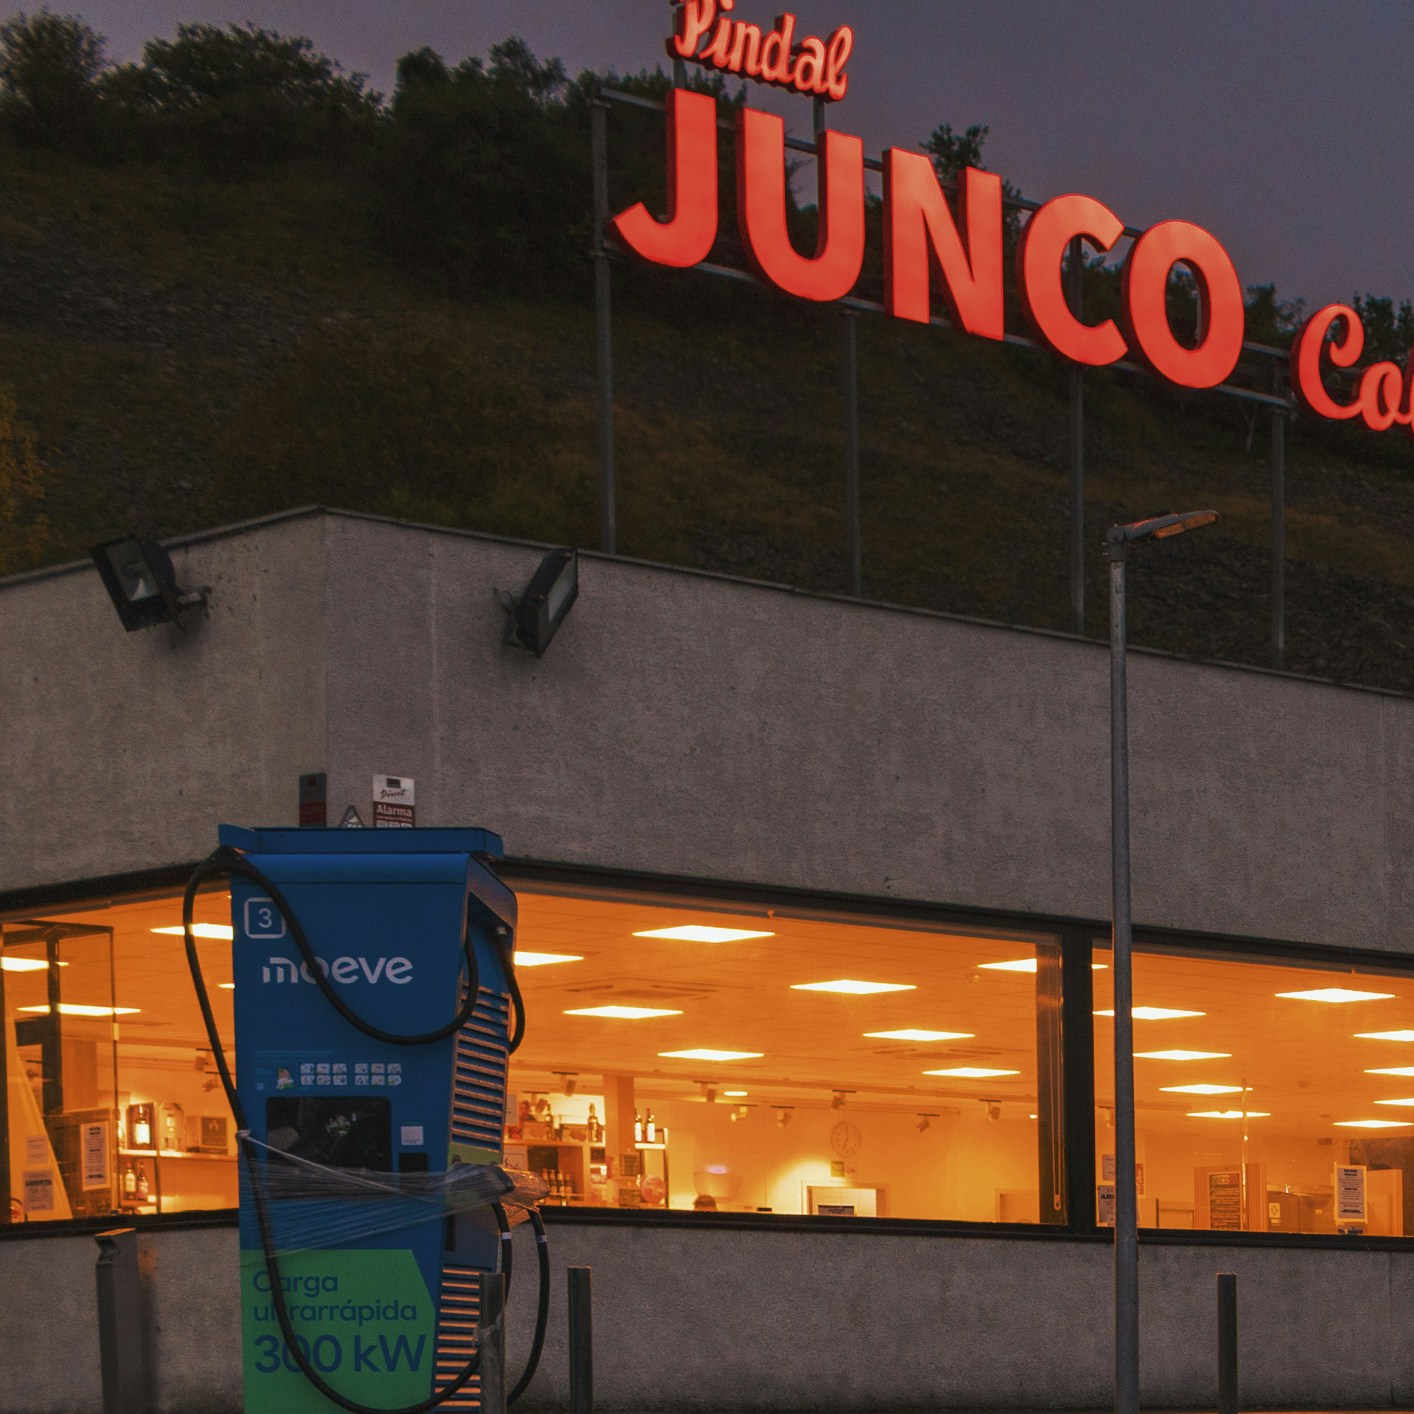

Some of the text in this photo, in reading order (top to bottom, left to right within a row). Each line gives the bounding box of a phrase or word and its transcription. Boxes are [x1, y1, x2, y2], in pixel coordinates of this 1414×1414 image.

[674, 0, 854, 100] Pindal
[611, 87, 1244, 389] JUNCO
[376, 803, 412, 817] Alarma
[257, 907, 273, 929] 3
[262, 956, 414, 985] moeve
[253, 1270, 338, 1298] Carga
[253, 1299, 417, 1327] ulrarrápida
[254, 1333, 427, 1373] 300 kW
